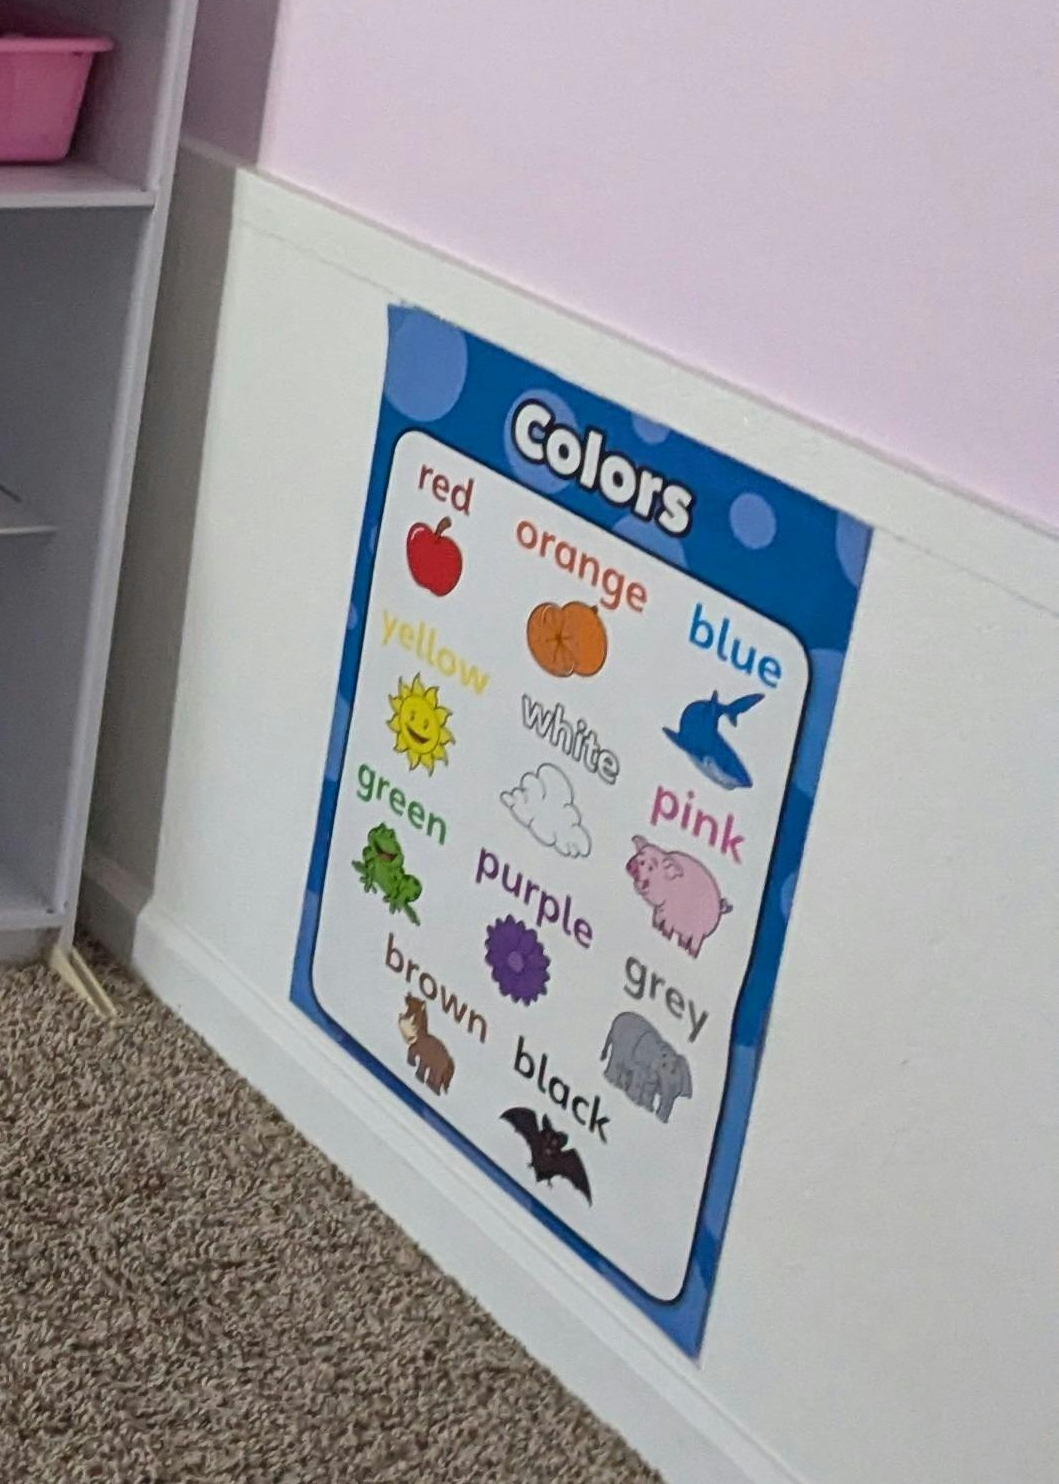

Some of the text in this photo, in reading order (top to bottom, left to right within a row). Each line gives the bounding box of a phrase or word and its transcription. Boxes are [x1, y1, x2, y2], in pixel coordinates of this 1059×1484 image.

[419, 464, 475, 516] red
[512, 399, 694, 536] Colors
[518, 519, 648, 612] orange
[382, 612, 489, 695] yellow
[690, 603, 782, 688] blue
[521, 694, 620, 786] white
[357, 764, 446, 845] green
[650, 785, 746, 864] pink
[476, 848, 593, 949] purple
[386, 933, 488, 1044] brown
[624, 956, 710, 1043] grey
[515, 1036, 610, 1144] black
